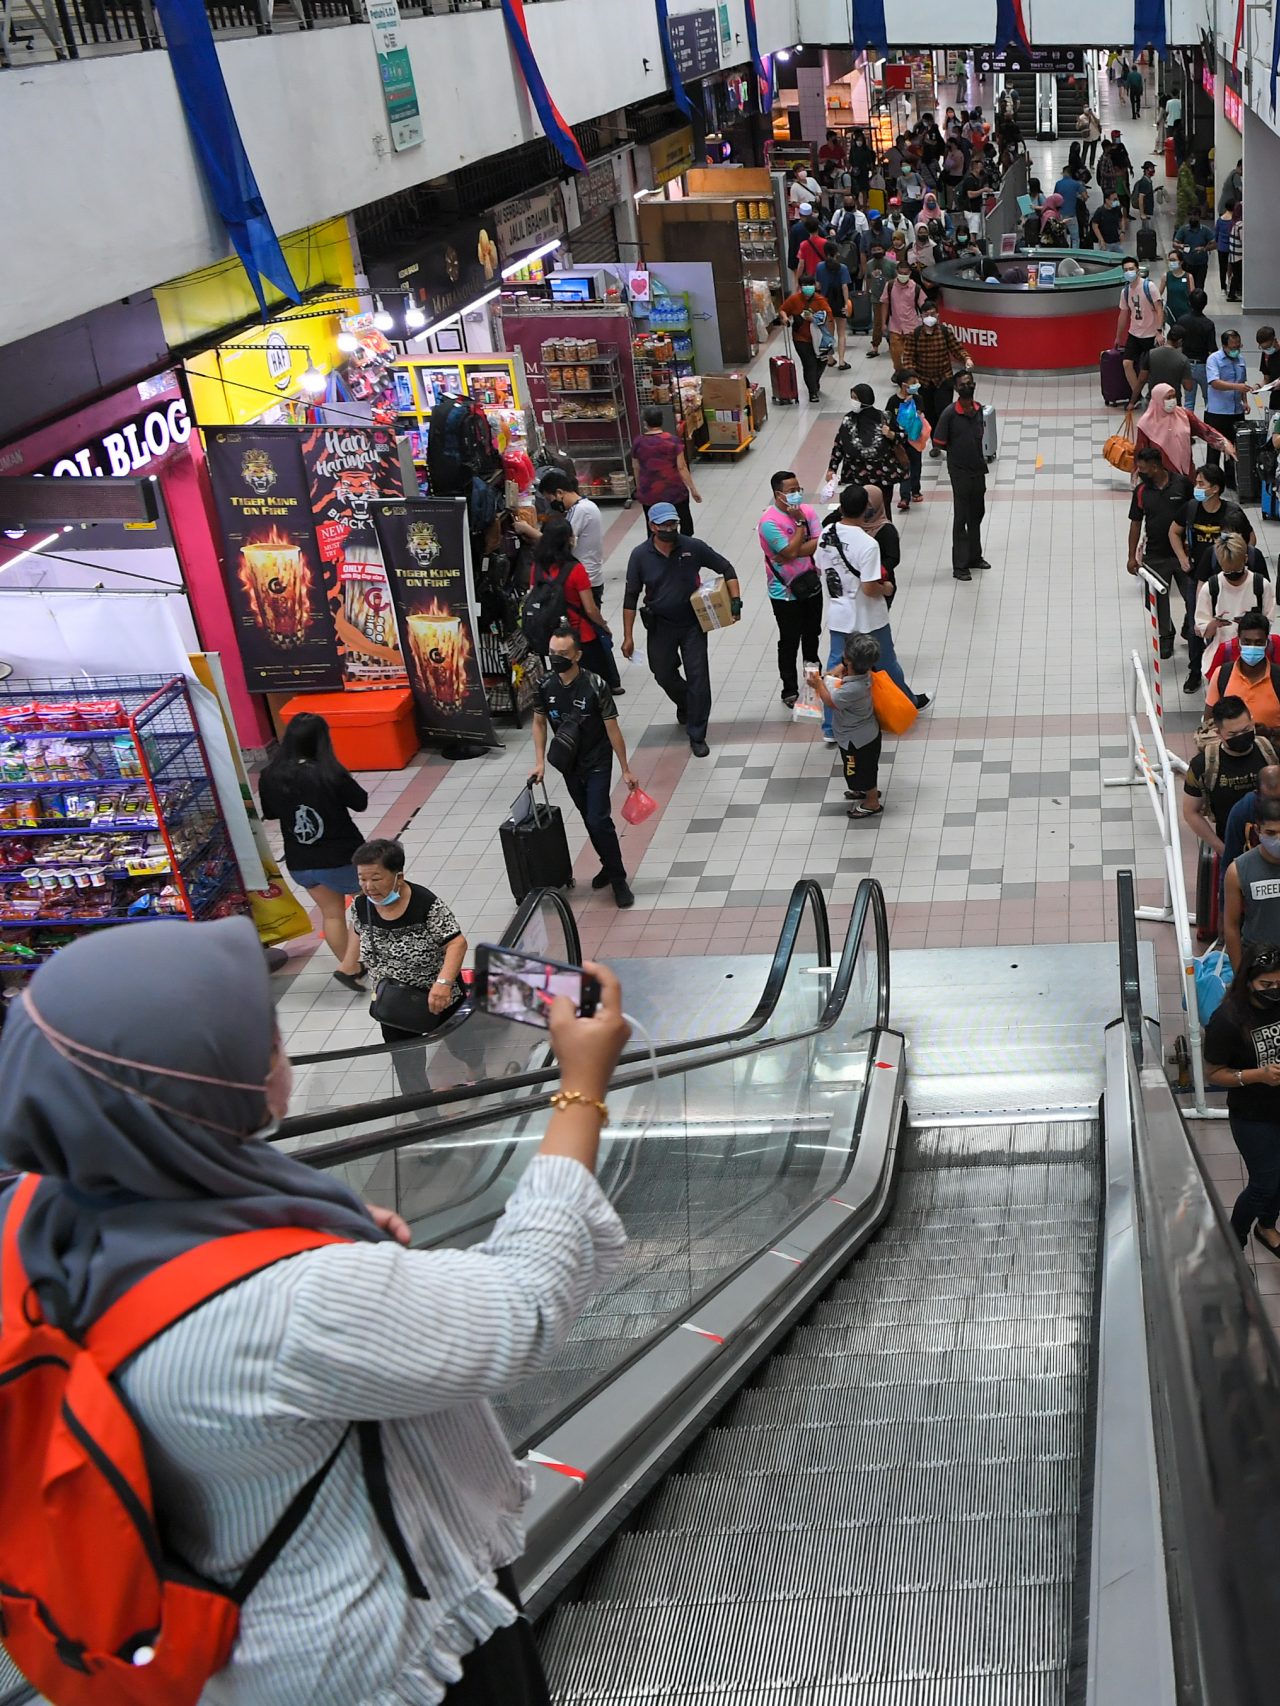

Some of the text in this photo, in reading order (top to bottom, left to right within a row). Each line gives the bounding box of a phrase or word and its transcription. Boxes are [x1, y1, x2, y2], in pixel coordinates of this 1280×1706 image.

[102, 398, 192, 477] BLOG
[324, 430, 371, 457] Hari
[316, 449, 381, 480] Harimau
[230, 496, 298, 507] TIGER KING
[243, 506, 289, 516] ON FIRE
[327, 507, 367, 530] BLACK
[321, 523, 347, 539] NEW
[323, 541, 341, 551] MUST
[342, 564, 364, 573] ONLY
[395, 568, 461, 578] TIGER KING
[406, 578, 451, 588] ON FIRE
[846, 754, 856, 776] FILA
